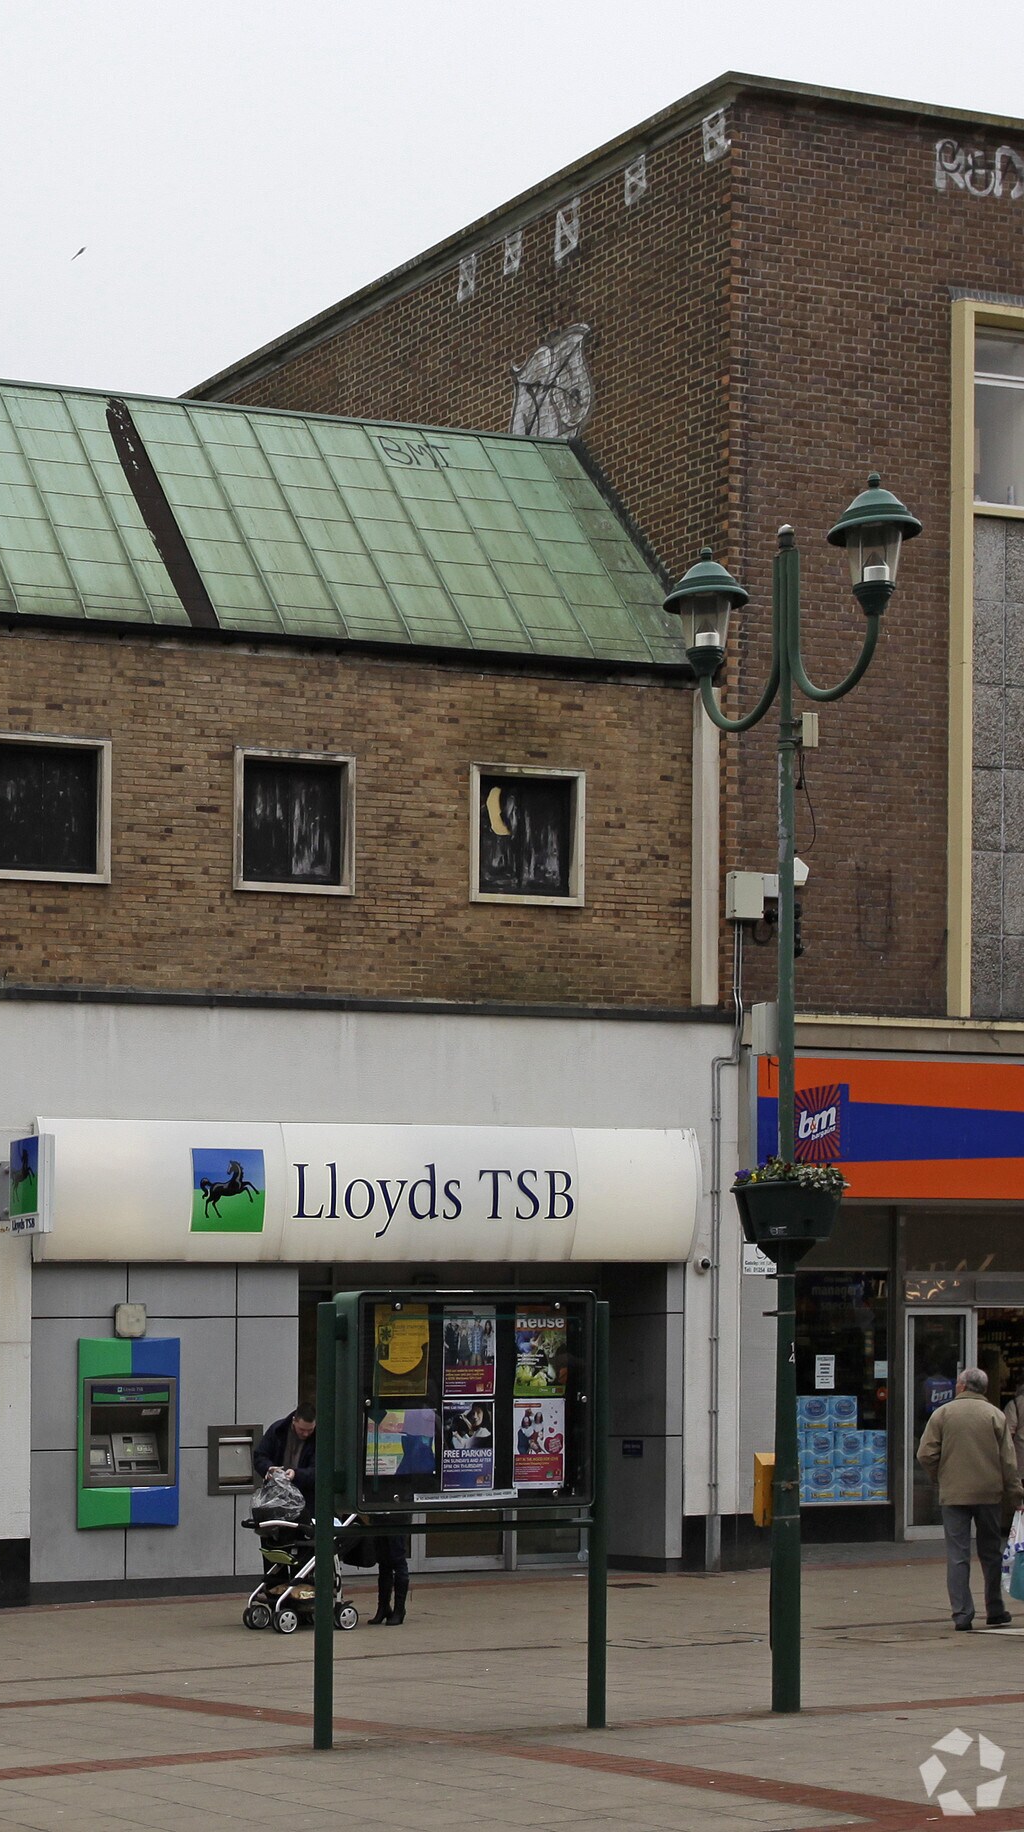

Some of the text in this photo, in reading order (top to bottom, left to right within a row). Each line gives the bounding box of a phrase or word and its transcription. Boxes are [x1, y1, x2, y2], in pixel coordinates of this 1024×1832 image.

[292, 1161, 574, 1238] Lloyds TSB
[11, 1217, 36, 1234] Lloyds TSB
[444, 1449, 493, 1458] FREE PARKING
